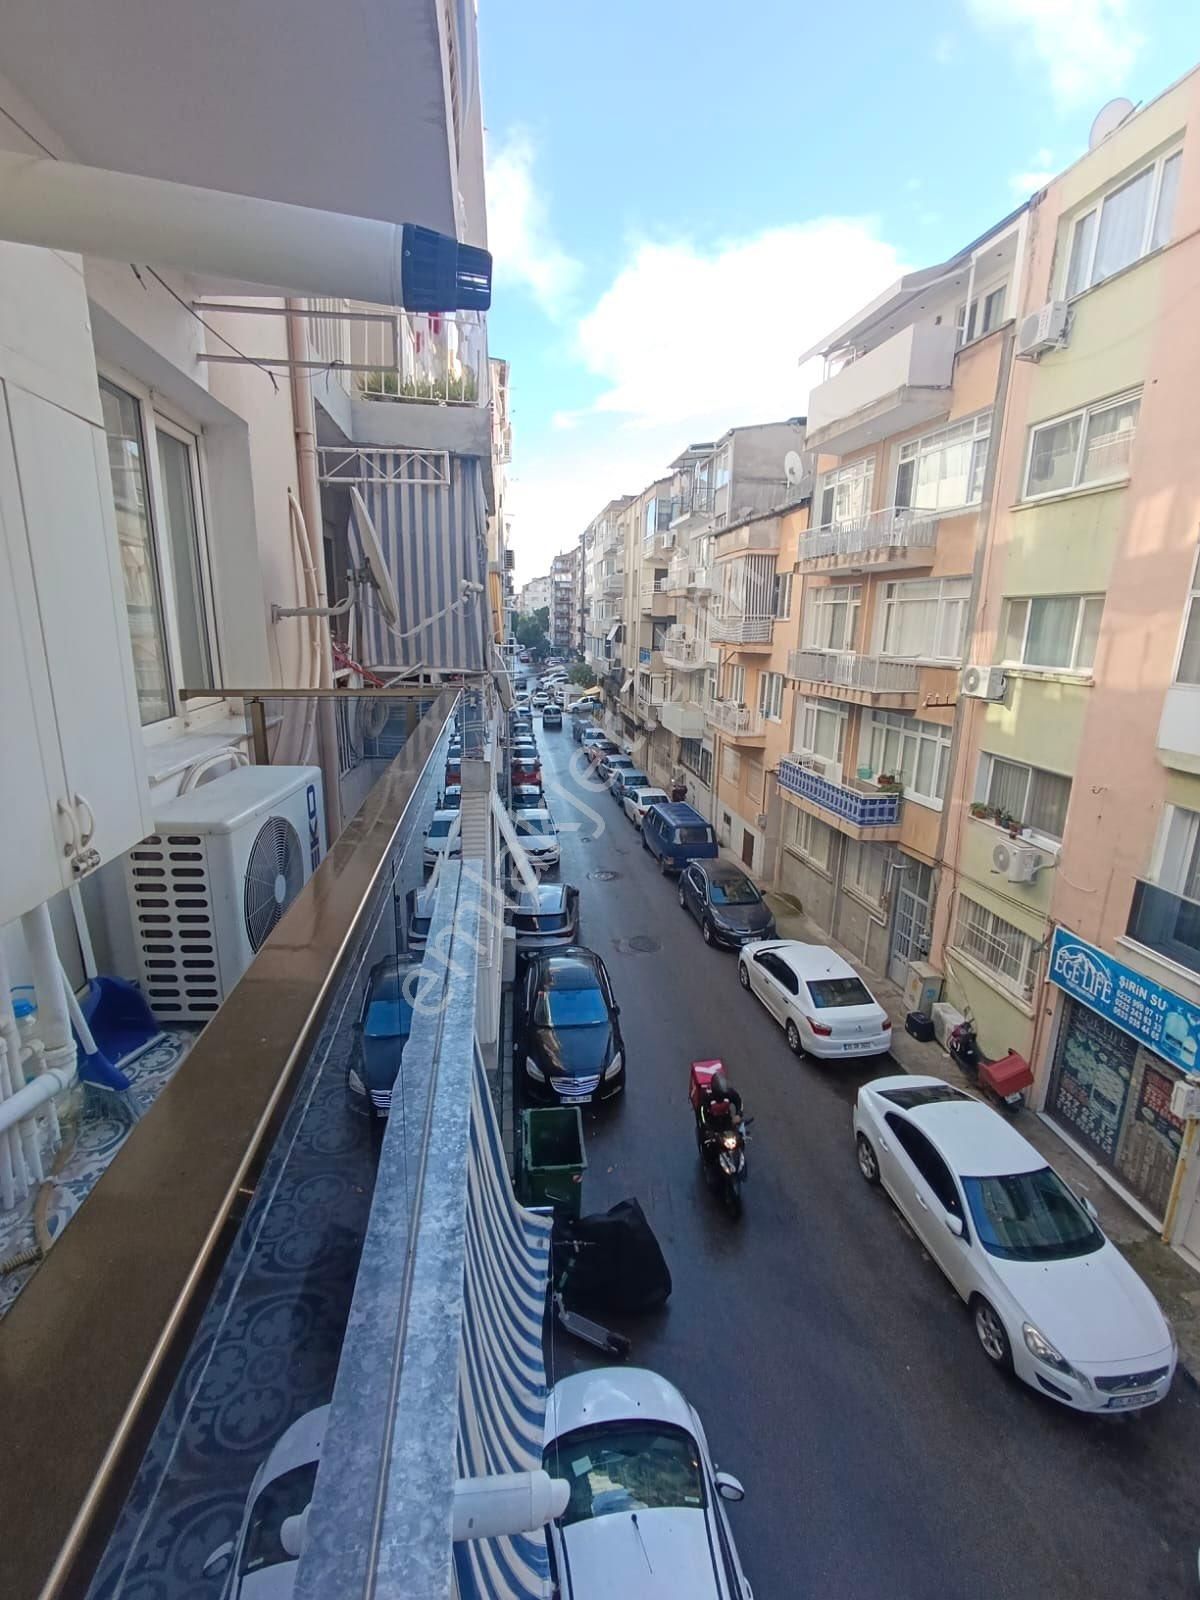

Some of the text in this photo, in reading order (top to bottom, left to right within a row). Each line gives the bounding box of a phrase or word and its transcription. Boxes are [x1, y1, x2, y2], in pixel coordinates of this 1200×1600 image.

[307, 784, 320, 873] EKO
[1054, 950, 1080, 984] EGE
[1081, 958, 1113, 1004] LIFE
[1150, 994, 1167, 1011] SU
